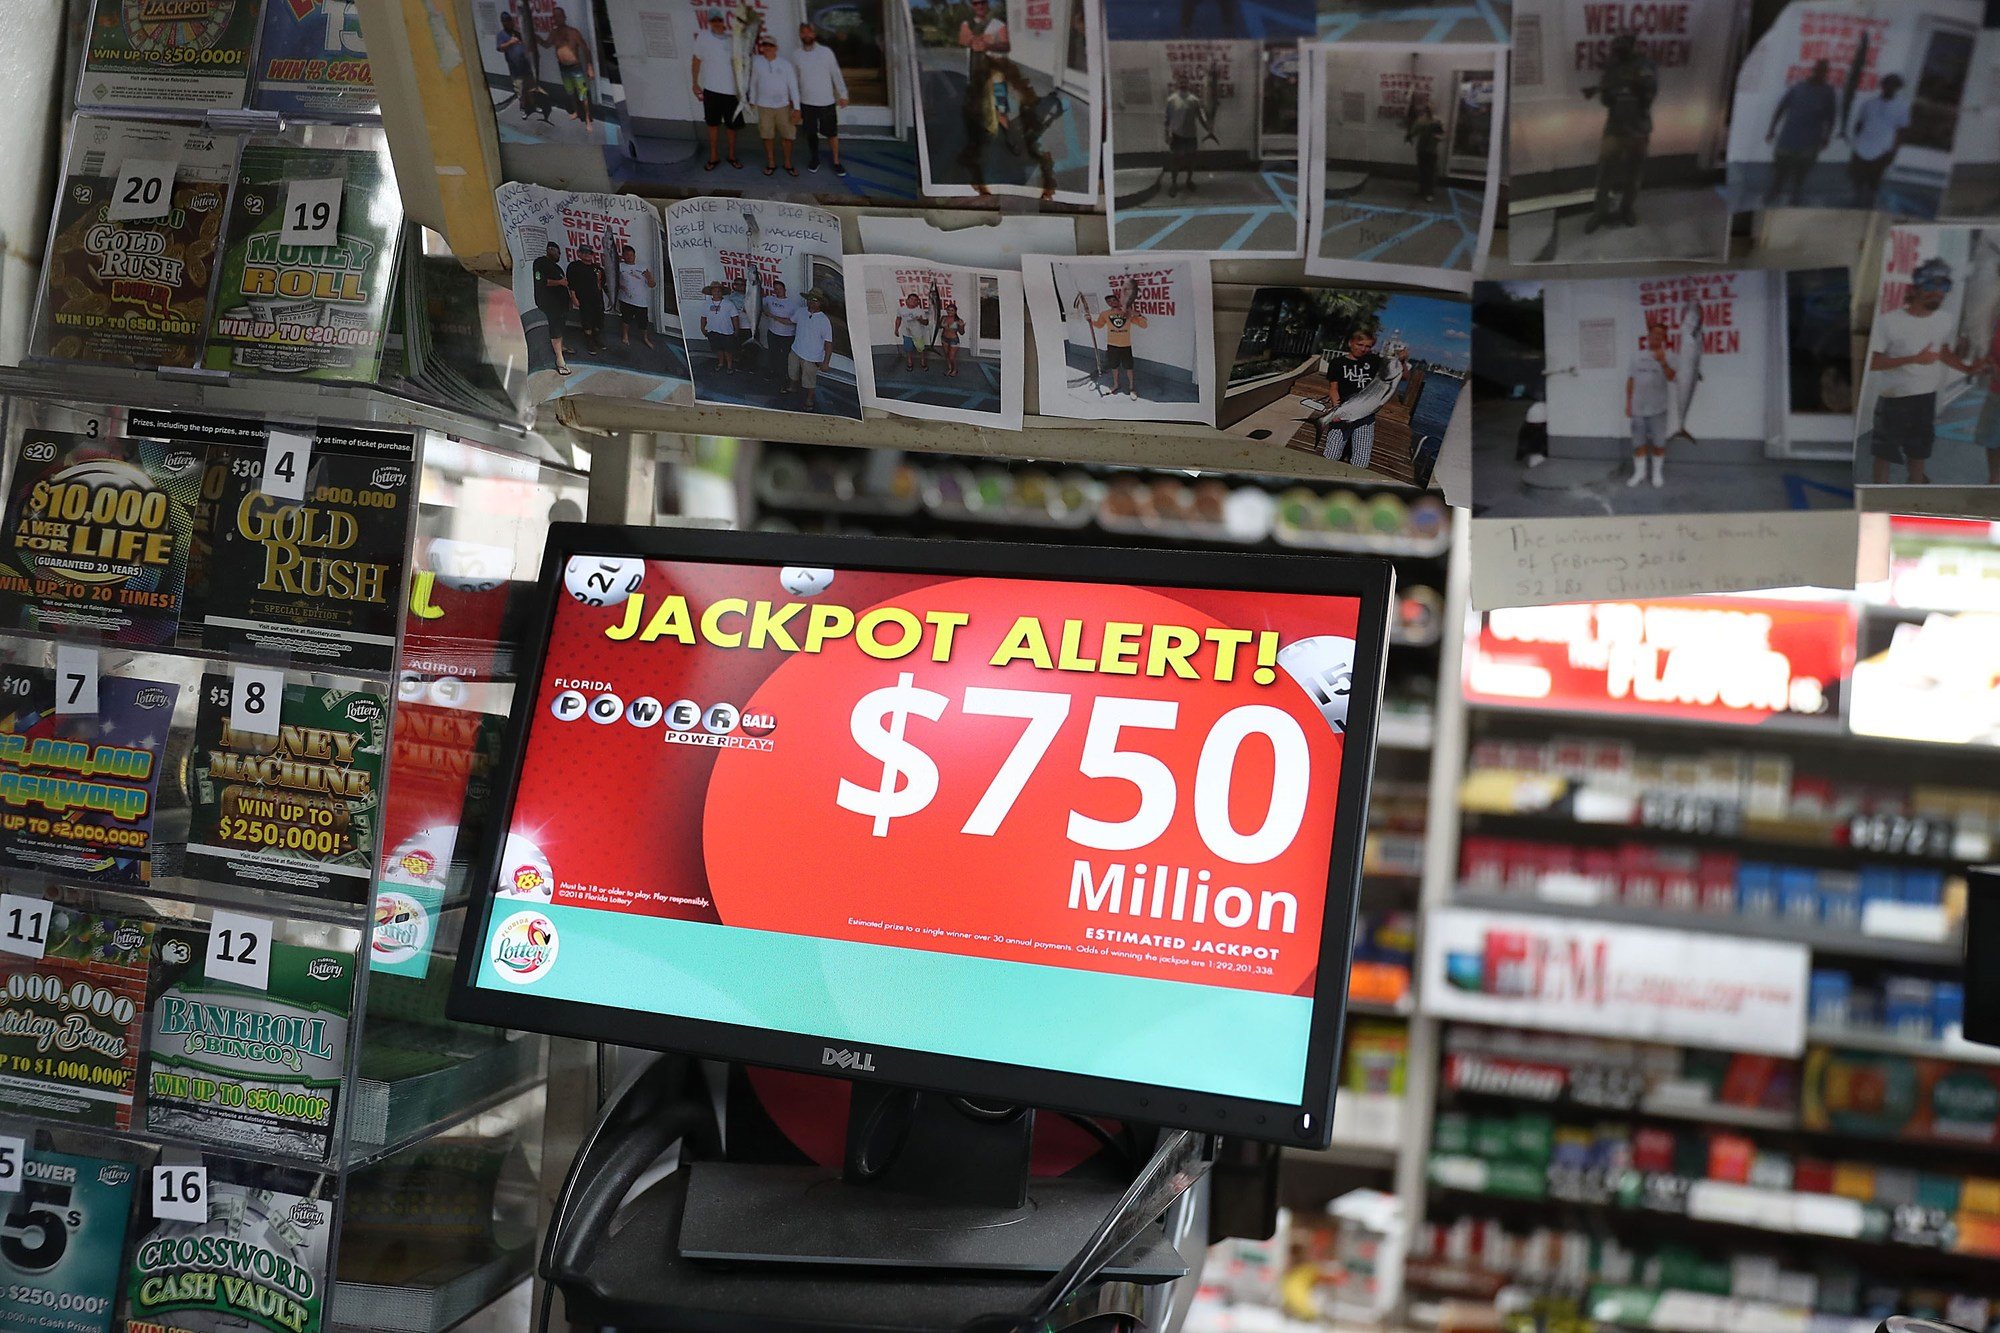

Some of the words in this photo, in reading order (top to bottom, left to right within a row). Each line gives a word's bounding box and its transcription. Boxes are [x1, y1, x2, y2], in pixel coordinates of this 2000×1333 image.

[147, 1, 207, 15] JACKPOT
[94, 50, 119, 59] WIN
[123, 51, 140, 60] UP
[144, 52, 160, 61] TO
[267, 60, 306, 79] WIN
[307, 60, 327, 71] UP
[75, 186, 91, 201] $2
[123, 177, 162, 204] 20
[190, 196, 219, 211] Lottery
[247, 196, 262, 212] $2
[671, 200, 718, 219] VANCE
[292, 202, 330, 231] 19
[563, 208, 630, 226] GATEWAY
[563, 217, 631, 237] SHELL
[85, 225, 165, 256] GOLD
[761, 242, 794, 256] 2017
[719, 250, 782, 264] GATEWAY
[720, 256, 782, 273] SHELL
[99, 250, 185, 287] RUSH
[1108, 269, 1174, 280] GATEWAY
[241, 266, 366, 301] ROLL
[1640, 285, 1738, 306] SHELL
[55, 313, 82, 325] WIN
[86, 316, 104, 327] UP
[108, 317, 127, 329] TO
[219, 319, 250, 336] WIN
[252, 320, 275, 338] UP
[280, 323, 301, 341] TO
[86, 419, 99, 438] 3
[132, 418, 155, 428] Prizes,
[157, 420, 188, 432] including
[189, 423, 201, 431] the
[202, 425, 213, 435] top
[215, 426, 237, 437] prizes,
[250, 430, 270, 440] subje
[25, 443, 55, 459] $20
[332, 437, 347, 446] time
[357, 439, 376, 449] ticket
[377, 441, 412, 452] purchase.
[162, 454, 197, 472] Lottery
[232, 458, 261, 478] $30
[274, 452, 295, 482] 4
[369, 469, 407, 490] Lottery
[30, 480, 167, 529] $10,000
[310, 486, 397, 509] ,000,000
[17, 520, 31, 534] A
[32, 521, 71, 538] WEEK
[237, 490, 359, 549] GOLD
[14, 536, 68, 553] FOR
[72, 526, 174, 565] LIFE
[34, 555, 95, 571] (GUARANTEED
[96, 563, 109, 573] 20
[111, 565, 144, 577] YEARS)
[257, 539, 390, 604] RUSH
[0, 577, 28, 591] WIN
[35, 580, 57, 594] UP
[65, 583, 86, 598] TO
[91, 586, 112, 601] 20
[119, 589, 176, 609] TIMES!
[264, 604, 300, 616] SPECIAL
[302, 608, 339, 620] EDITION
[279, 626, 299, 634] website
[604, 592, 970, 663] JACKPOT
[988, 616, 1281, 686] ALERT!
[3, 676, 31, 696] $10
[66, 673, 86, 704] 7
[554, 678, 613, 692] FLORIDA
[133, 691, 169, 709] Lottery
[210, 686, 230, 707] $5
[244, 682, 266, 713] 8
[344, 702, 381, 723] Lottery
[208, 751, 371, 797] MACHINE
[836, 671, 1312, 865] $750
[238, 798, 274, 818] WIN
[280, 804, 304, 821] UP
[309, 807, 333, 826] TO
[3, 814, 26, 830] UP
[29, 817, 51, 834] TO
[558, 889, 583, 899] ©2018
[584, 892, 608, 902] Florida
[609, 895, 633, 906] Lottery
[559, 881, 576, 890] Must
[577, 883, 587, 891] be
[588, 884, 598, 892] 18
[607, 887, 625, 896] older
[634, 891, 651, 900] play.
[653, 892, 668, 902] Play
[668, 895, 710, 907] responsibly.
[1067, 859, 1299, 934] Million
[6, 908, 44, 944] 11
[501, 917, 530, 938] FLORIDA
[110, 930, 145, 950] Lottery
[216, 929, 258, 965] 12
[847, 917, 883, 929] Estimated
[884, 923, 904, 932] prize
[922, 927, 944, 937] single
[946, 930, 972, 939] winner
[993, 934, 1004, 943] 30
[1005, 937, 1032, 947] annual
[1034, 941, 1073, 952] payments.
[1076, 944, 1099, 955] Odds
[1100, 947, 1109, 955] of
[1110, 950, 1143, 962] winning
[1145, 952, 1158, 961] the
[1159, 955, 1190, 967] jackpot
[1085, 927, 1186, 950] ESTIMATED
[1191, 940, 1280, 961] JACKPOT
[493, 937, 552, 966] Lottery
[307, 960, 343, 981] Lottery
[0, 973, 136, 1025] ,000,000
[0, 1009, 57, 1053] liday
[56, 1013, 128, 1059] Bonus
[159, 996, 333, 1060] BANKROLL
[204, 1035, 283, 1063] BINGO
[821, 1047, 876, 1072] DELL
[11, 1055, 31, 1073] TO
[153, 1073, 189, 1098] WIN
[192, 1079, 217, 1101] UP
[220, 1082, 244, 1106] TO
[0, 1147, 14, 1179] 5
[24, 1160, 77, 1183] OWER
[96, 1166, 131, 1186] Lottery
[159, 1170, 201, 1204] 16
[286, 1205, 324, 1228] Lottery
[137, 1236, 315, 1300] CROSSWORD
[139, 1271, 218, 1306] CASH
[221, 1274, 309, 1333] VAULT
[39, 1316, 65, 1330] Cash
